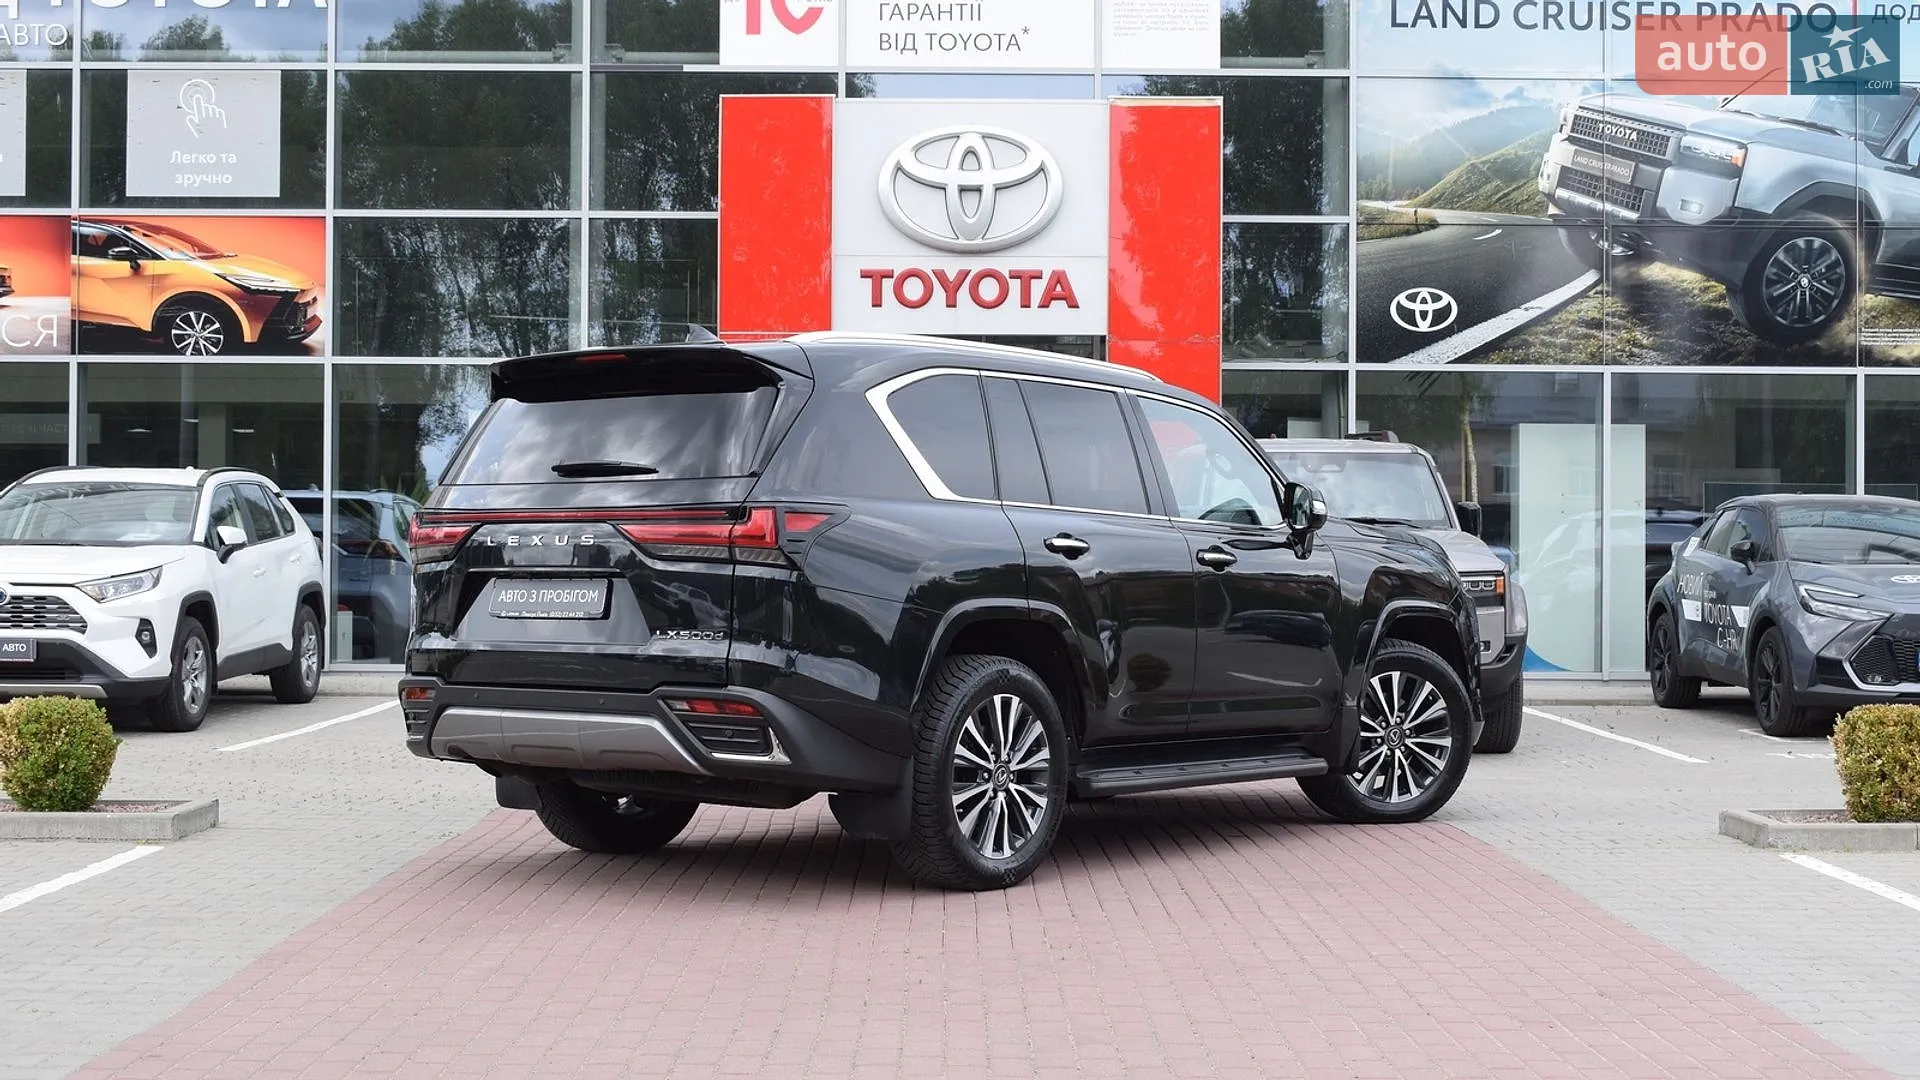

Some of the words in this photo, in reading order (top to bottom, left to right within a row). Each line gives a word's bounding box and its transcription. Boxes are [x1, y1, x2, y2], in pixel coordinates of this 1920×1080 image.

[1390, 0, 1500, 29] LAND
[1512, 0, 1682, 32] CRUISER
[1697, 2, 1838, 33] PRADO
[879, 33, 918, 55] ВІД
[1598, 122, 1638, 141] TOYOTA
[169, 150, 217, 164] Легко
[219, 152, 237, 164] та
[175, 173, 233, 188] зручно
[860, 268, 1080, 309] TOYOTA
[487, 534, 595, 547] LEXUS
[498, 589, 528, 603] АВТО
[539, 589, 600, 604] ПРОБІГОМ
[1703, 602, 1732, 626] TOYOTA
[2, 643, 27, 652] АВТО
